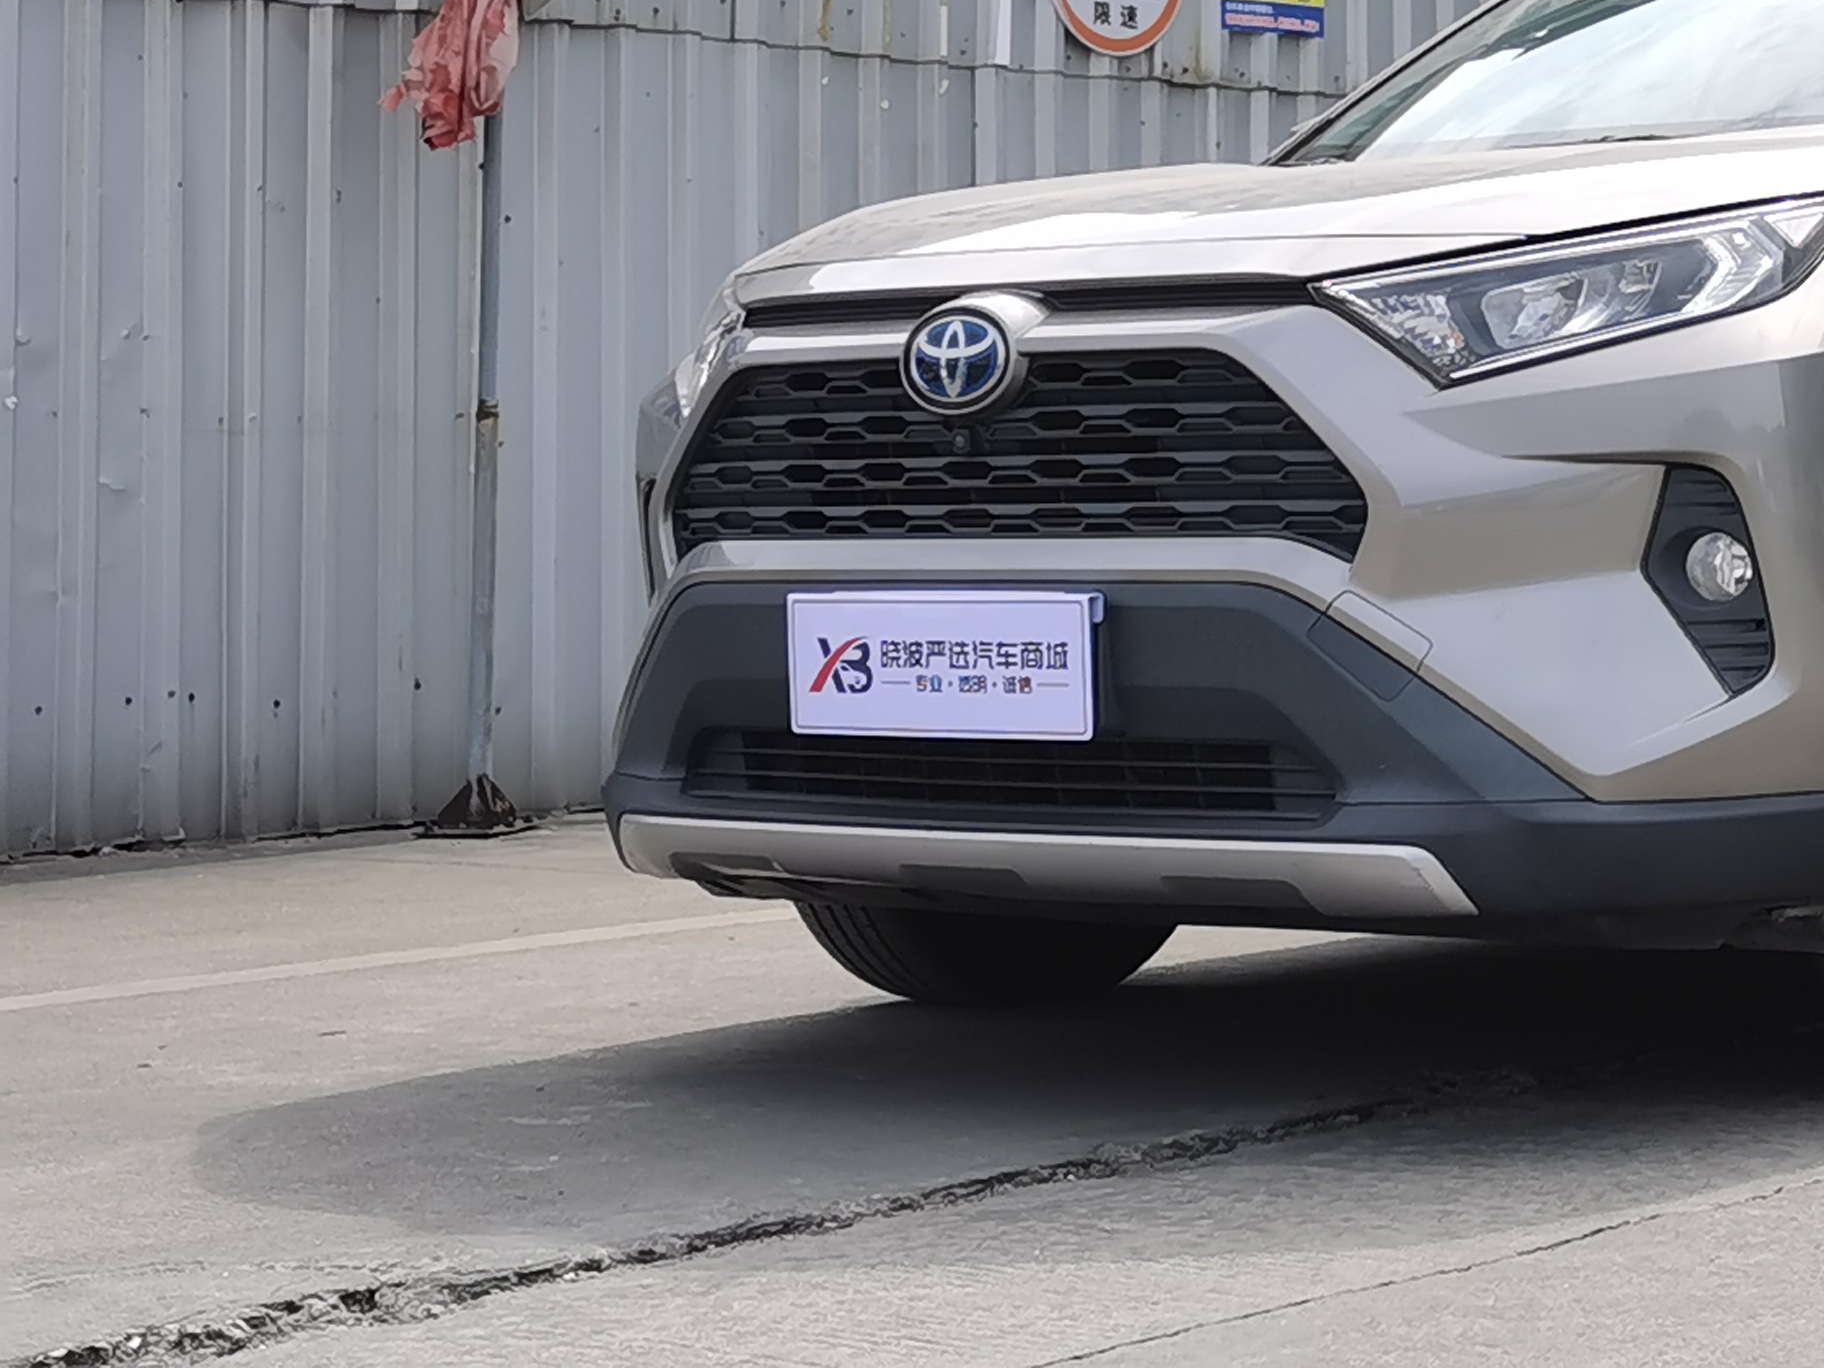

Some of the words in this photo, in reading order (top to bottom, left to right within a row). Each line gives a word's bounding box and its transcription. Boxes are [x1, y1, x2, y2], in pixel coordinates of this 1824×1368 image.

[879, 639, 1069, 671] 晓波严选汽车商城
